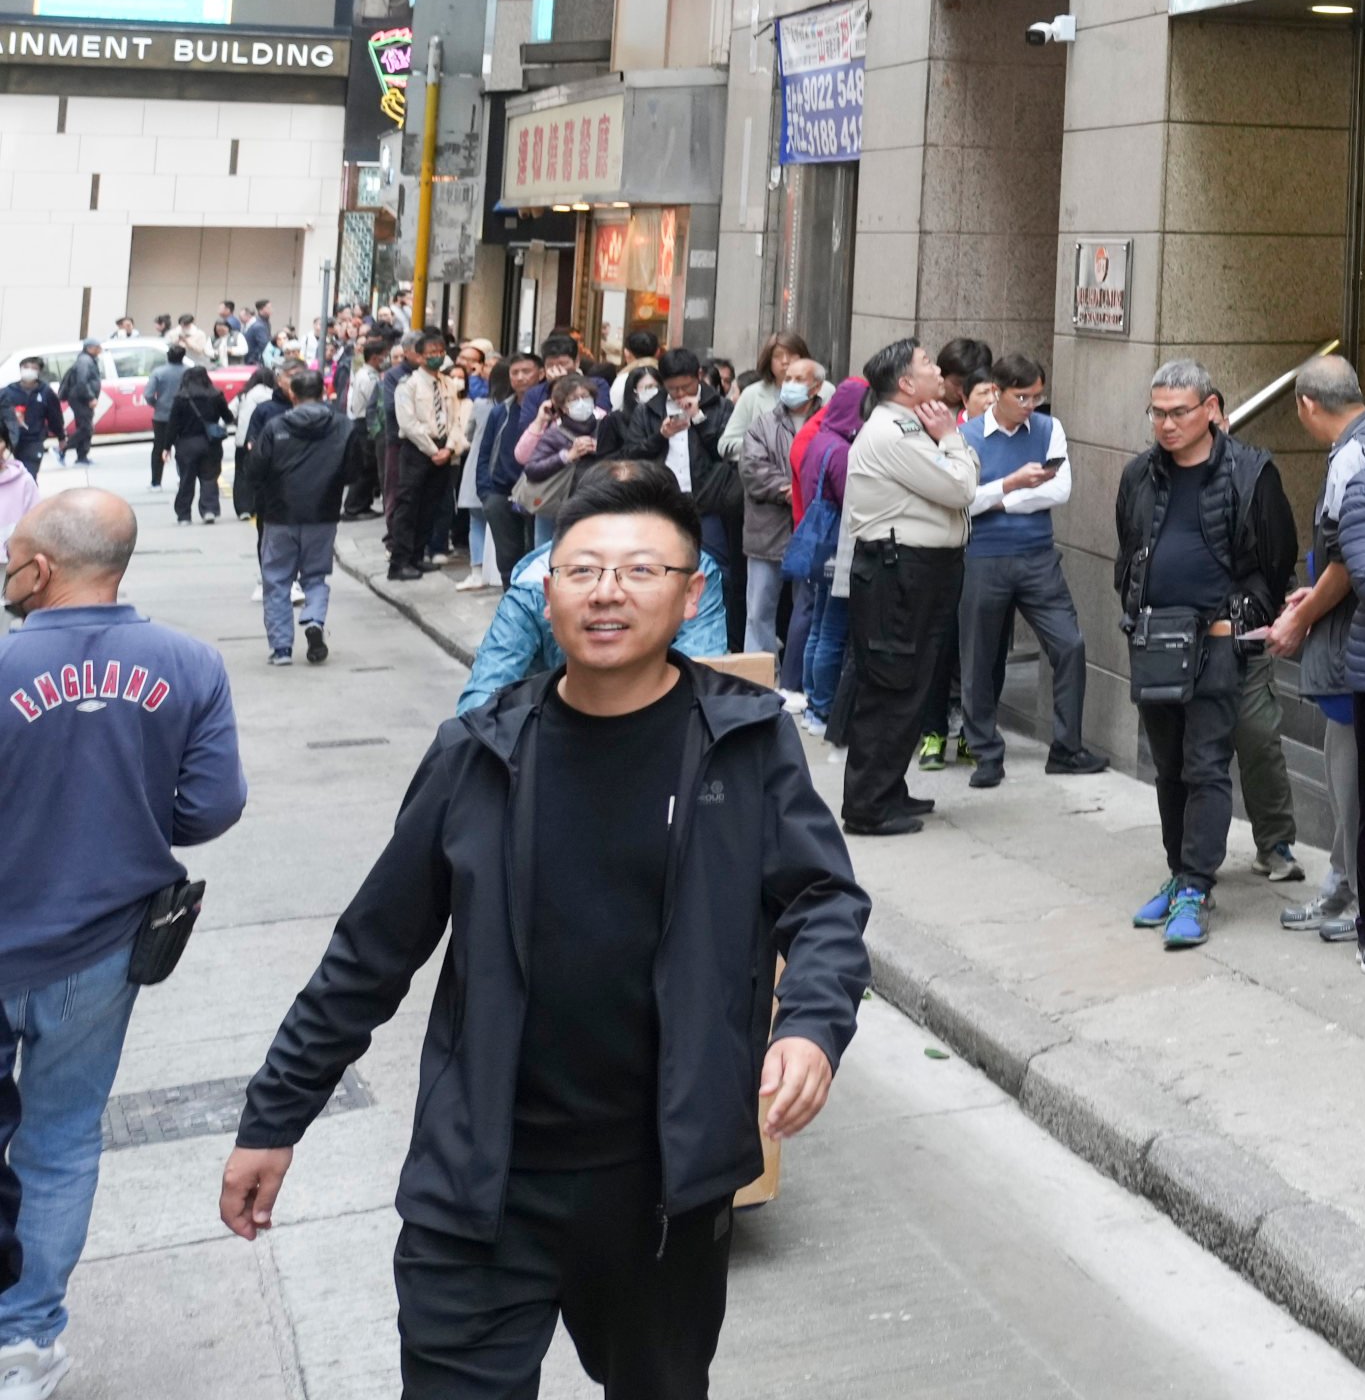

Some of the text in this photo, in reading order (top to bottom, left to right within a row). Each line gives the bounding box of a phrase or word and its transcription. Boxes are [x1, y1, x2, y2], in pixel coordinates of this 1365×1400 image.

[173, 39, 335, 68] BUILDING
[802, 72, 835, 113] 9022
[806, 118, 838, 156] 3188
[10, 658, 170, 723] ENGLAND
